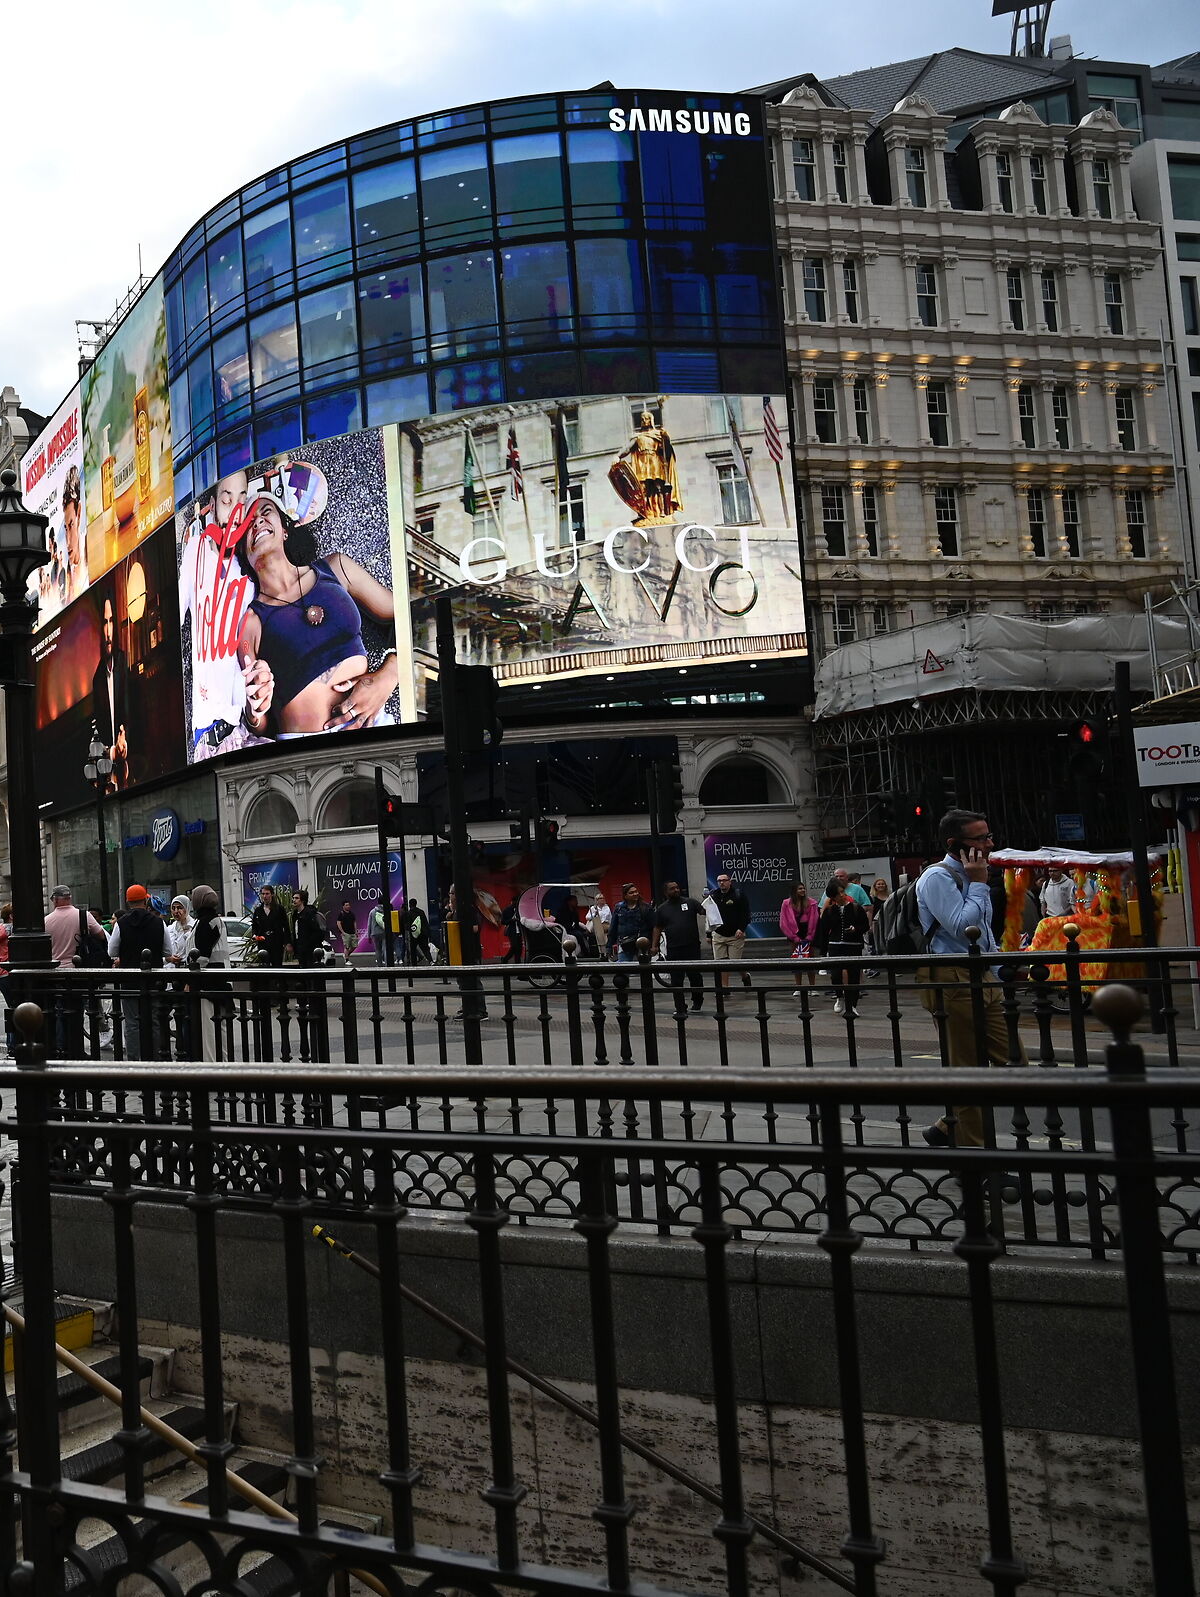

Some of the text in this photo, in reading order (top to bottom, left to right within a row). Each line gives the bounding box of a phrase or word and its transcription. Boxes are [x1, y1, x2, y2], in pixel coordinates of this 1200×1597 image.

[609, 107, 751, 136] SAMSUNG
[459, 525, 750, 585] GUCCI
[153, 816, 173, 852] Boots
[714, 842, 753, 856] PRIME
[722, 856, 787, 870] retail space
[809, 863, 835, 872] COMING
[730, 868, 795, 882] AVAILABLE
[809, 871, 835, 880] SUMME
[332, 878, 360, 891] by an
[810, 881, 826, 889] 2023
